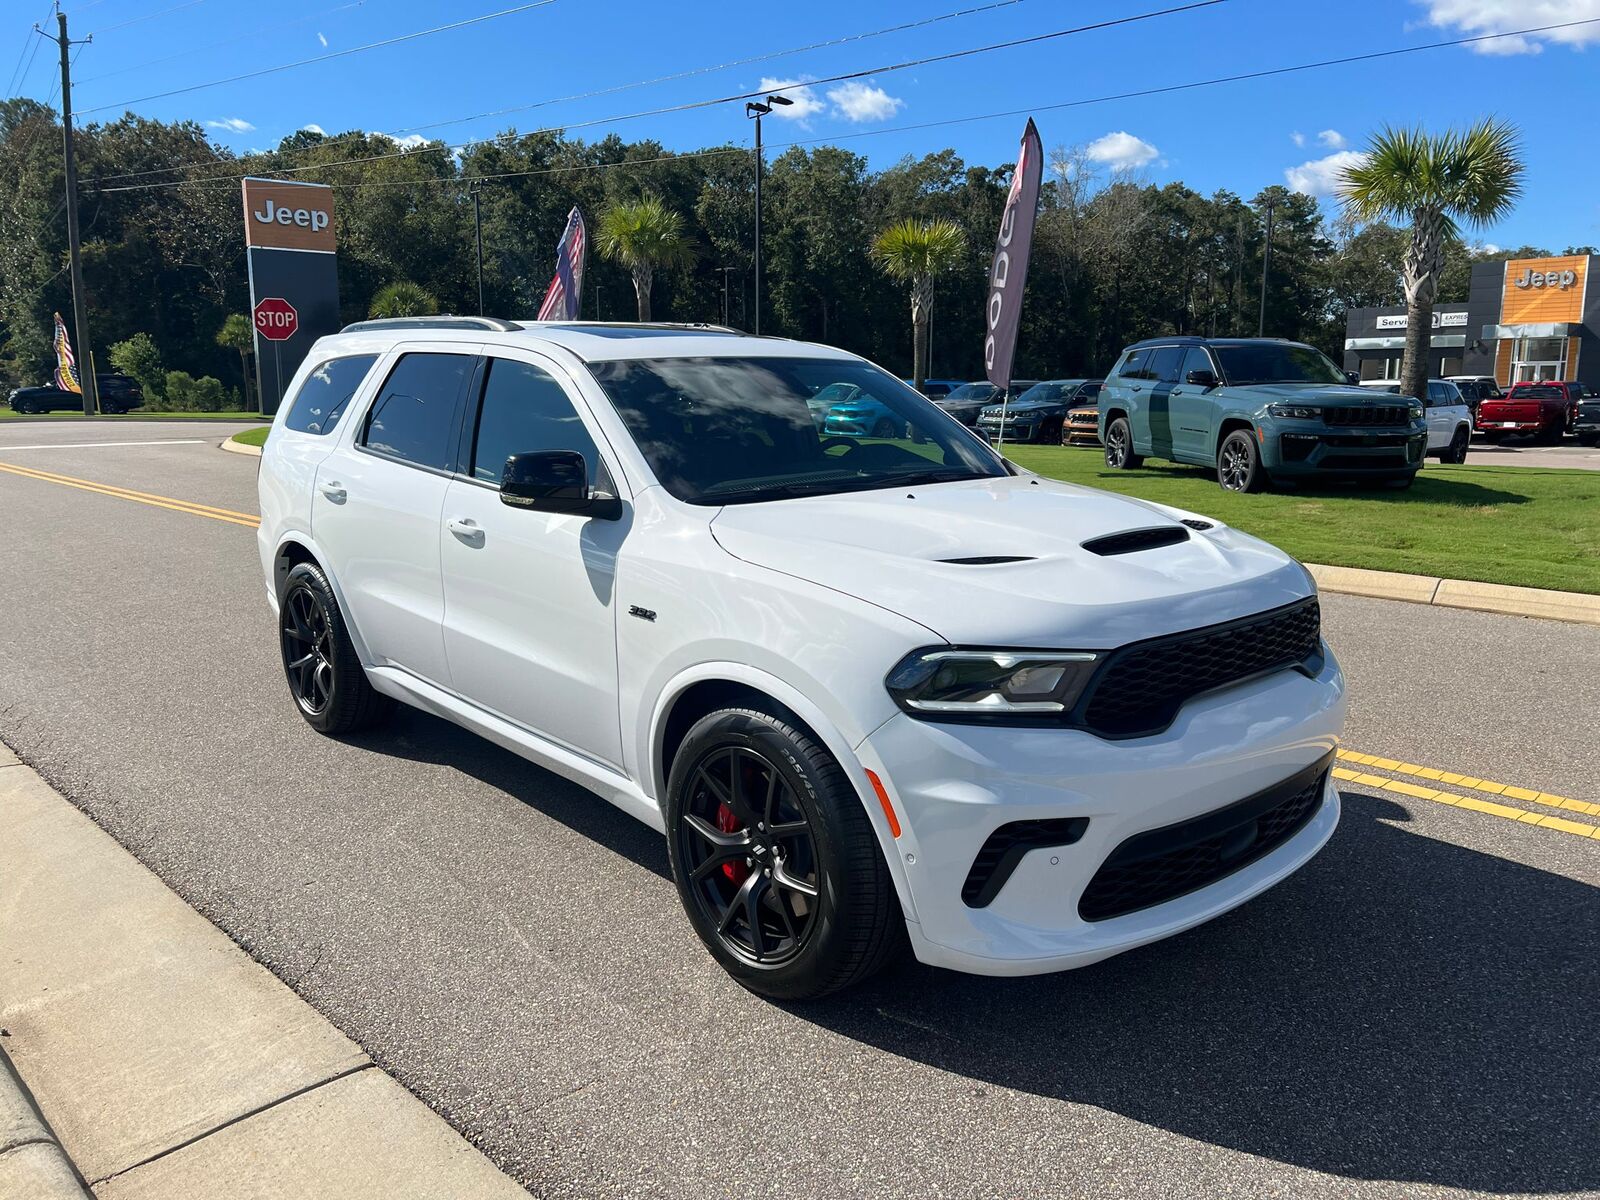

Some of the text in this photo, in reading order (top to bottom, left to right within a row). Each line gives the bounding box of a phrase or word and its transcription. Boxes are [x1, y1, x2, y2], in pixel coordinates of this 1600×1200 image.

[254, 200, 329, 232] Jeep
[1514, 267, 1576, 289] Jeep
[984, 209, 1016, 370] DODG
[257, 311, 294, 327] STOP
[1382, 317, 1407, 326] Servi
